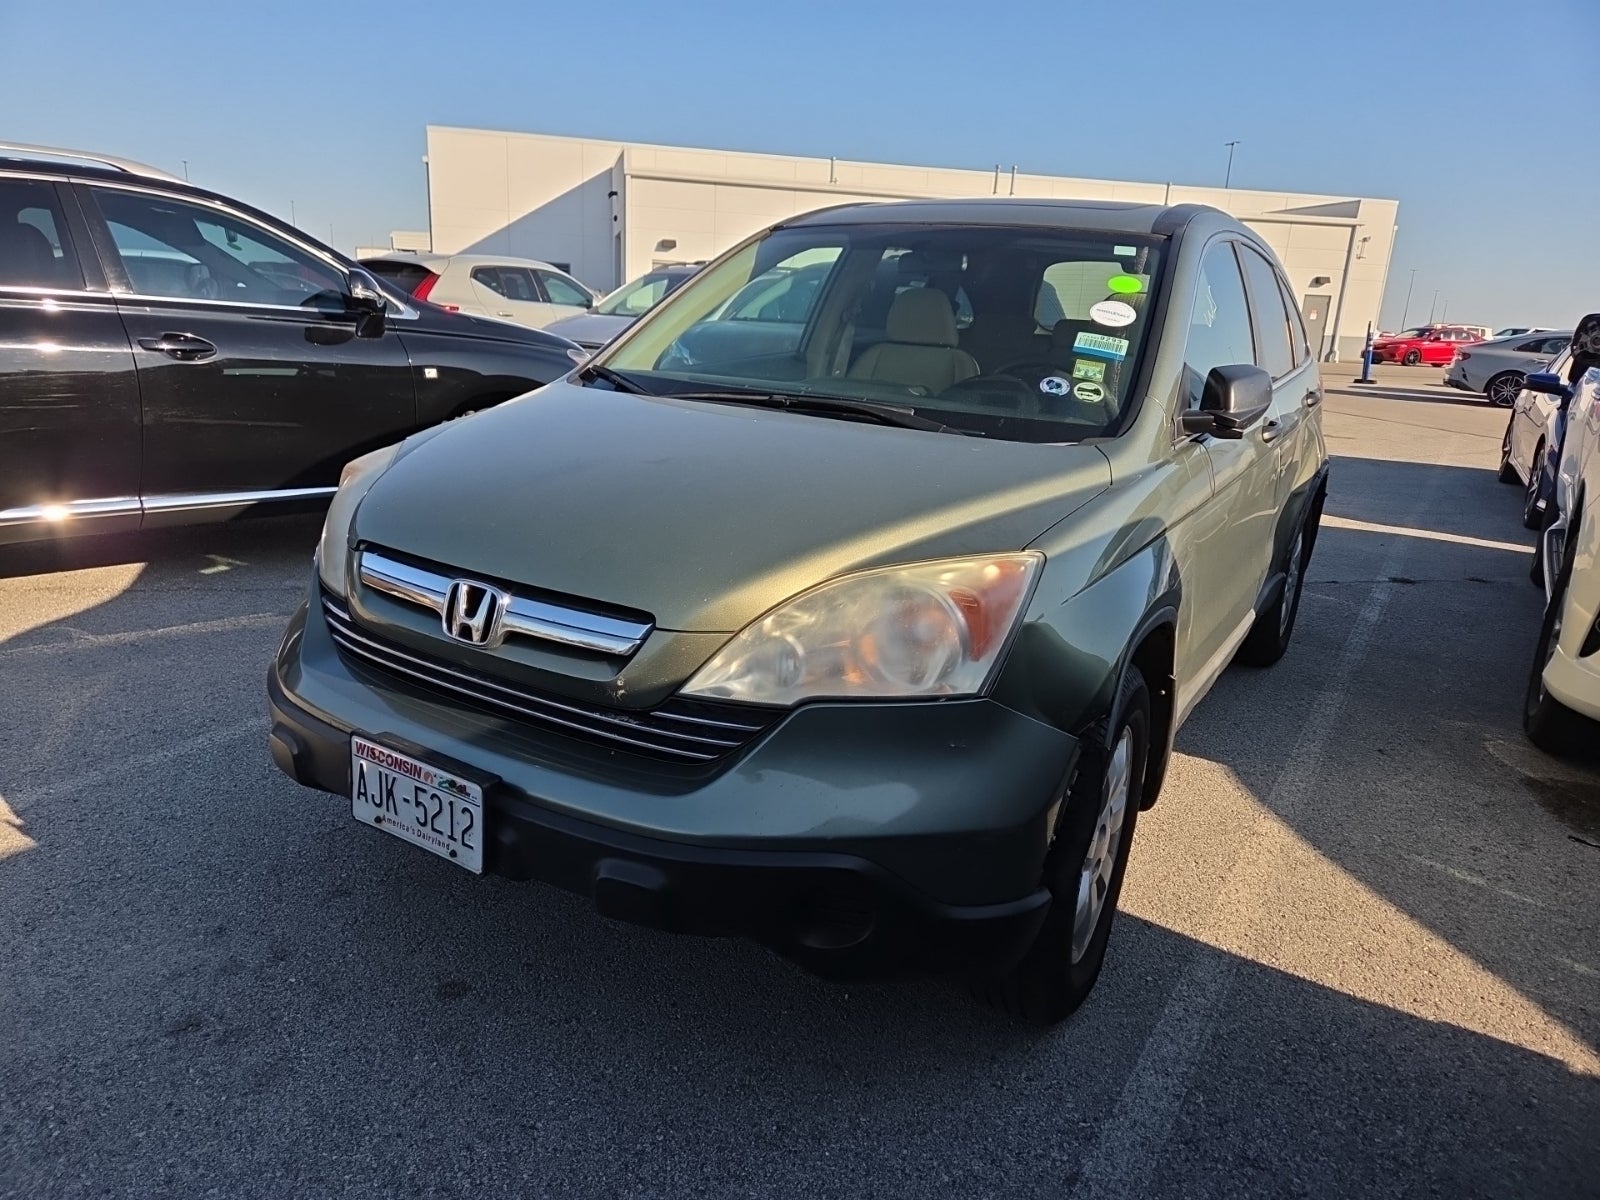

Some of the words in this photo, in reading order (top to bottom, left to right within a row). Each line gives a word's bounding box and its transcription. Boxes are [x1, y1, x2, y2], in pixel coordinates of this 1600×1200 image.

[355, 741, 422, 779] WISCONSIN
[357, 761, 474, 850] AJK-5212
[382, 815, 416, 834] America's
[416, 830, 451, 851] Dairyland
